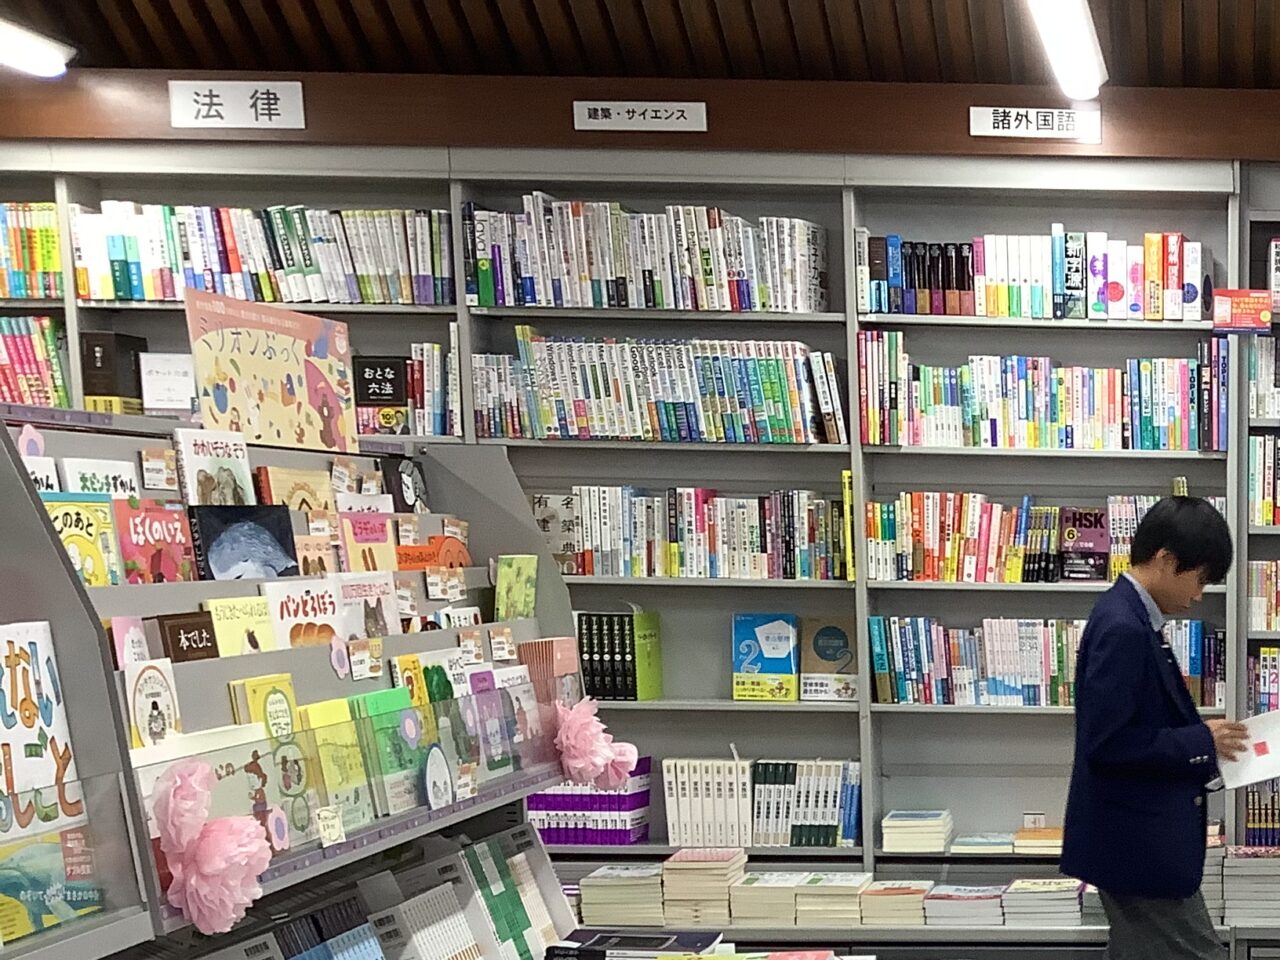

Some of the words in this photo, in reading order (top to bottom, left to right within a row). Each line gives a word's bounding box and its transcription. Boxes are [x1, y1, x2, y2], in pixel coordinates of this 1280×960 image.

[586, 106, 689, 122] 建築・サイエンス
[991, 108, 1077, 132] 諸外国語
[199, 315, 301, 367] ミリオンぶっく
[363, 367, 395, 380] おとな
[367, 381, 395, 395] 六法
[128, 513, 187, 546] ぼくのいえ
[1071, 511, 1106, 530] HSK
[279, 593, 336, 621] パンどろぼう
[178, 629, 212, 650] 本でした
